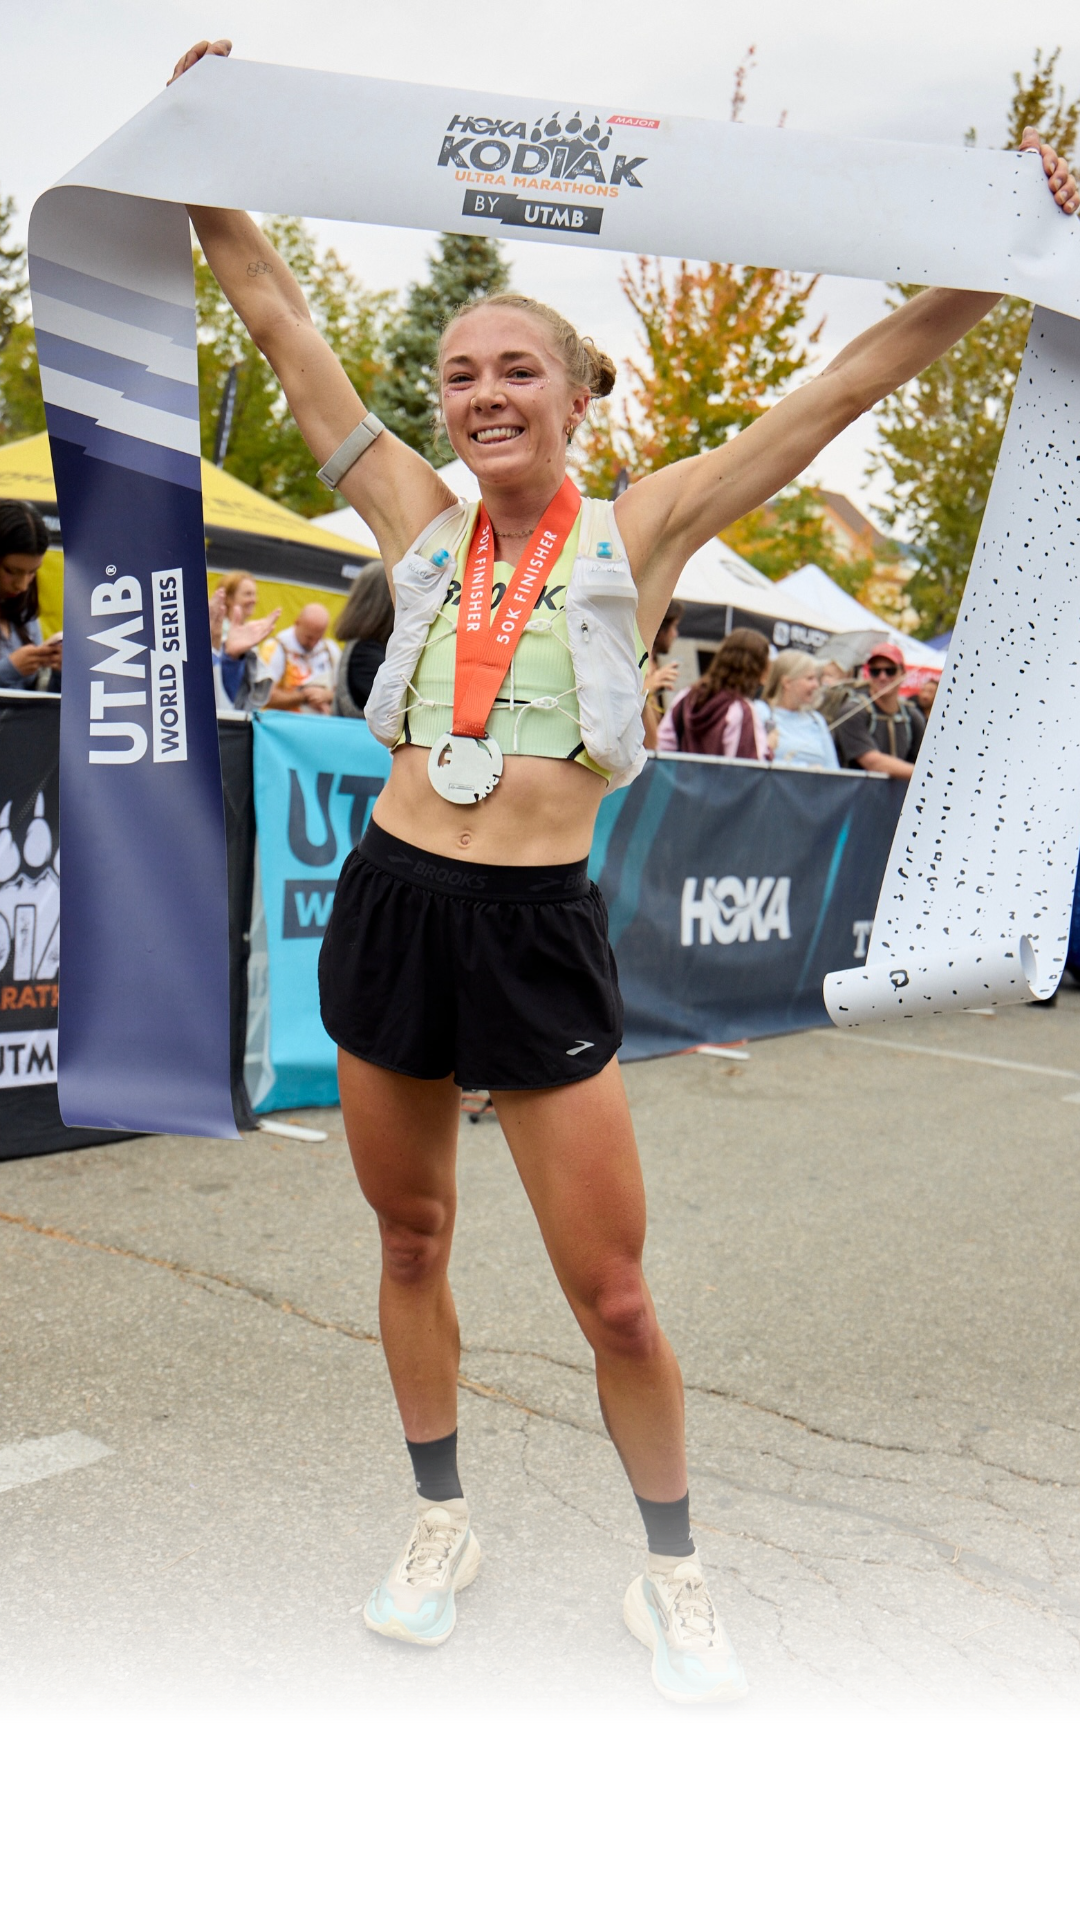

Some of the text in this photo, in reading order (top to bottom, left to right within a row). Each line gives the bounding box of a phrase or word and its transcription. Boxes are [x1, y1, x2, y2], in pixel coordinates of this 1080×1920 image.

[447, 115, 528, 139] HOKA
[614, 116, 656, 128] MAJOR
[437, 135, 649, 188] KODIAK
[455, 170, 619, 198] ULTRA MARATHONS
[474, 196, 500, 213] BY
[466, 557, 487, 632] FINISHER
[496, 530, 558, 645] 50K FINISHER
[159, 575, 180, 754] WORLD SERIES
[412, 860, 489, 890] BROOKS
[680, 875, 792, 947] HOKA
